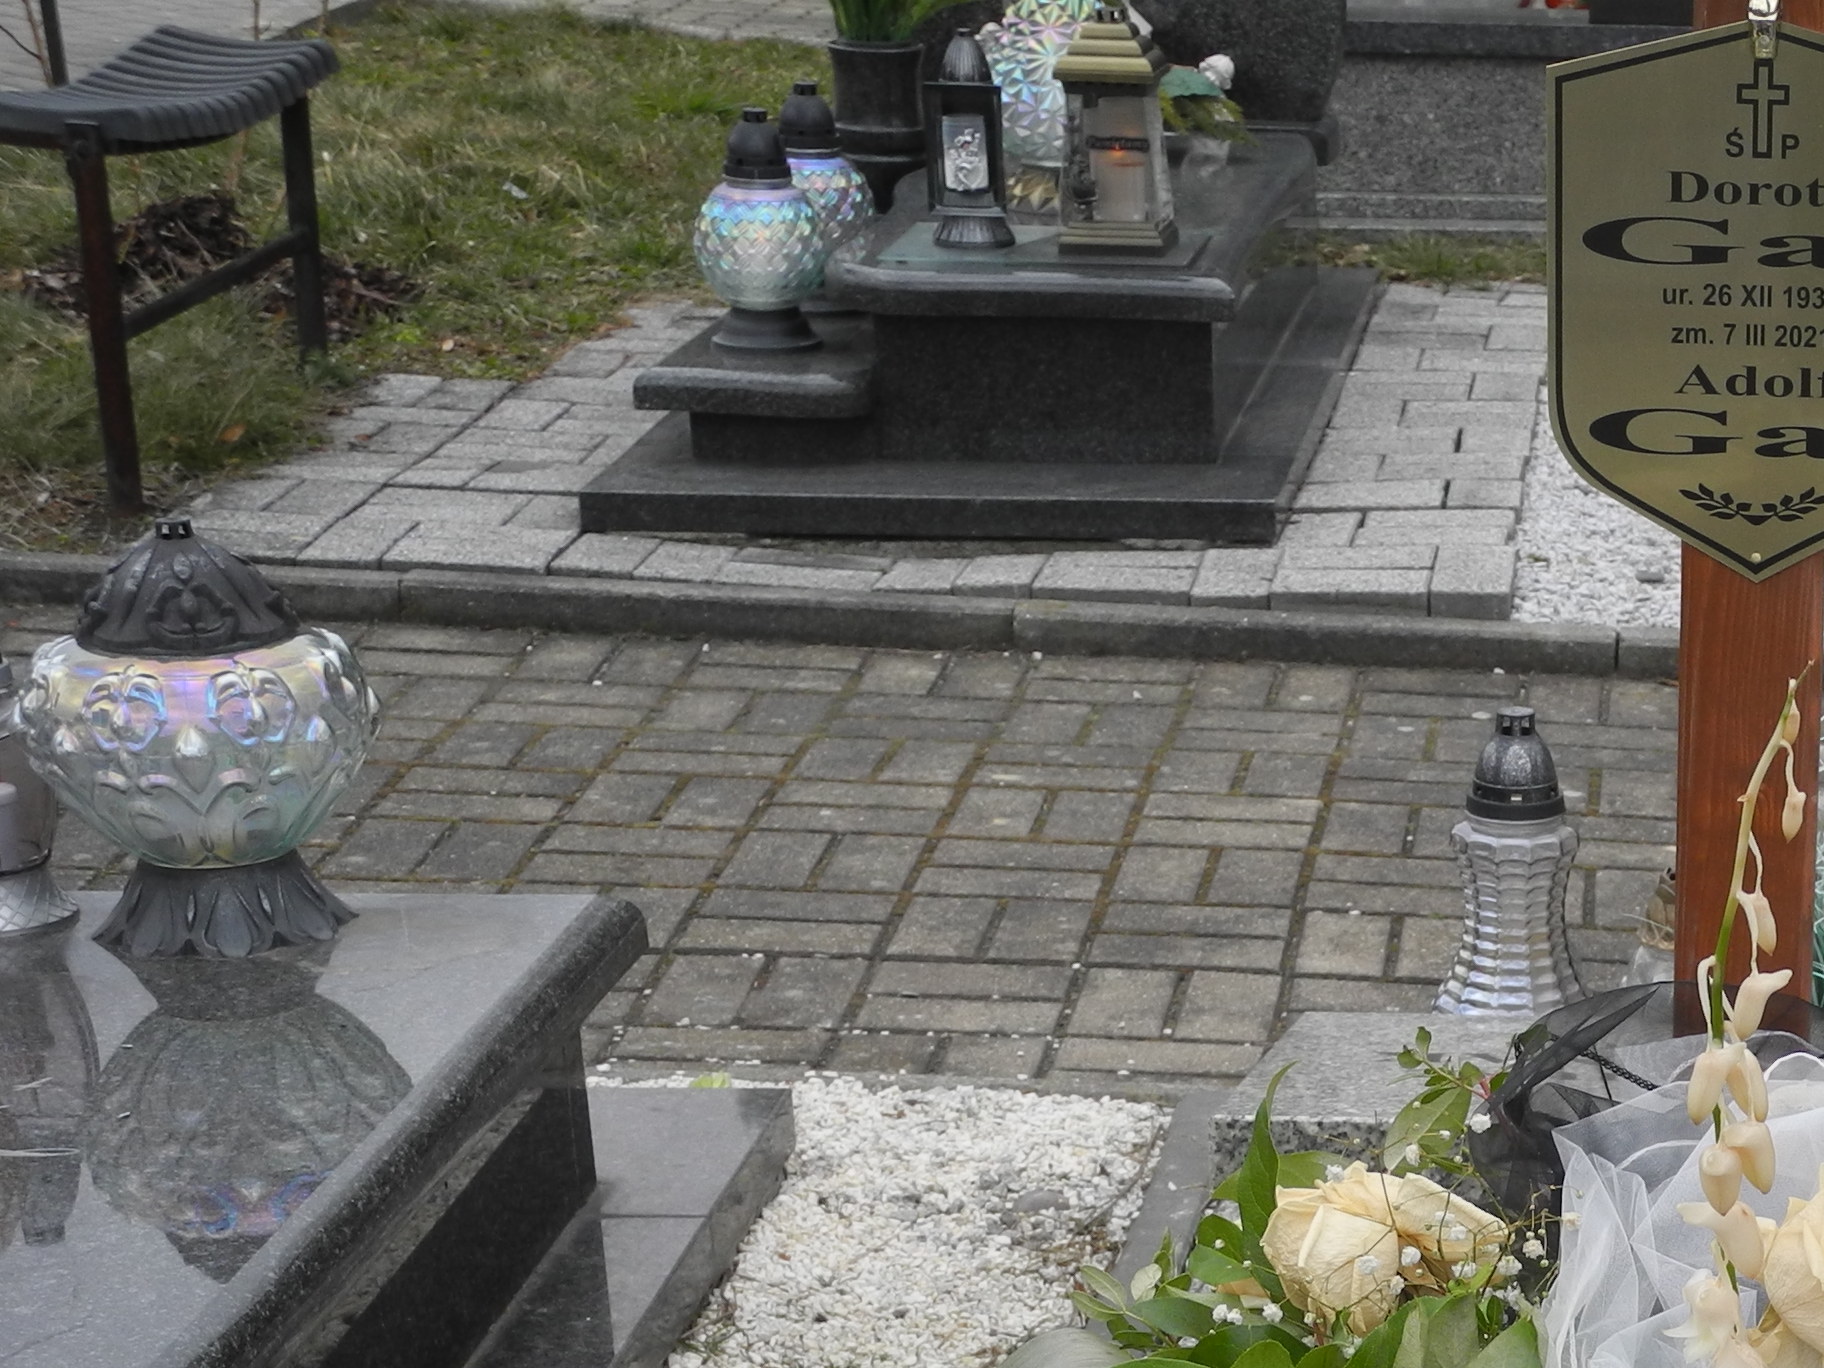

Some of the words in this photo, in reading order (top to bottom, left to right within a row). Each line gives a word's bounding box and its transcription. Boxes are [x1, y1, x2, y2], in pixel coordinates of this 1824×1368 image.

[1781, 133, 1800, 160] P
[1662, 287, 1694, 307] ur.
[1702, 283, 1732, 307] 26
[1740, 284, 1773, 308] XII
[1671, 327, 1715, 346] zm.
[1723, 323, 1737, 346] 7
[1745, 323, 1766, 347] III
